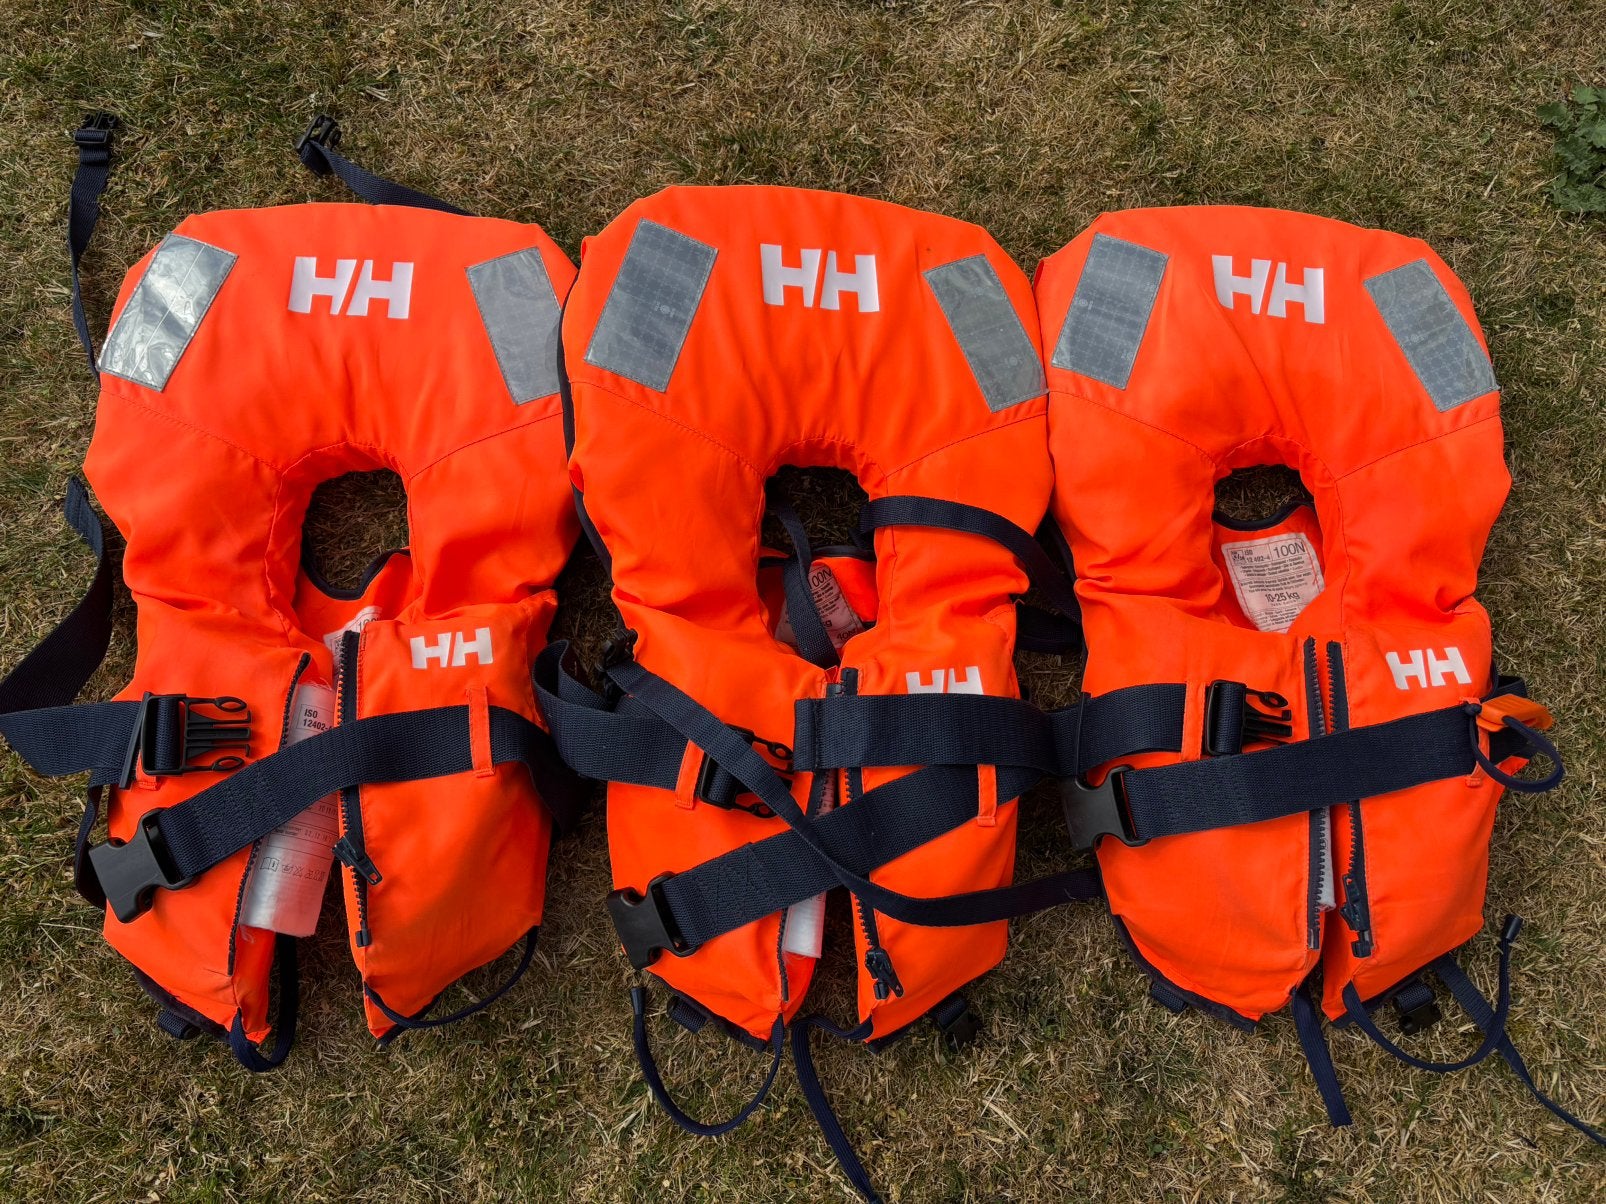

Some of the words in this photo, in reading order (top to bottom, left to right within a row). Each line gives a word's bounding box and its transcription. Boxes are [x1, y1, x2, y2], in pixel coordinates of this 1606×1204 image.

[289, 256, 415, 320] HH
[761, 243, 880, 313] HH
[1212, 254, 1326, 324] HH
[1273, 541, 1305, 558] 100N
[1286, 591, 1300, 600] kg
[410, 627, 494, 670] HH
[1386, 646, 1472, 690] HH
[905, 665, 984, 695] HH
[304, 708, 318, 718] ISO
